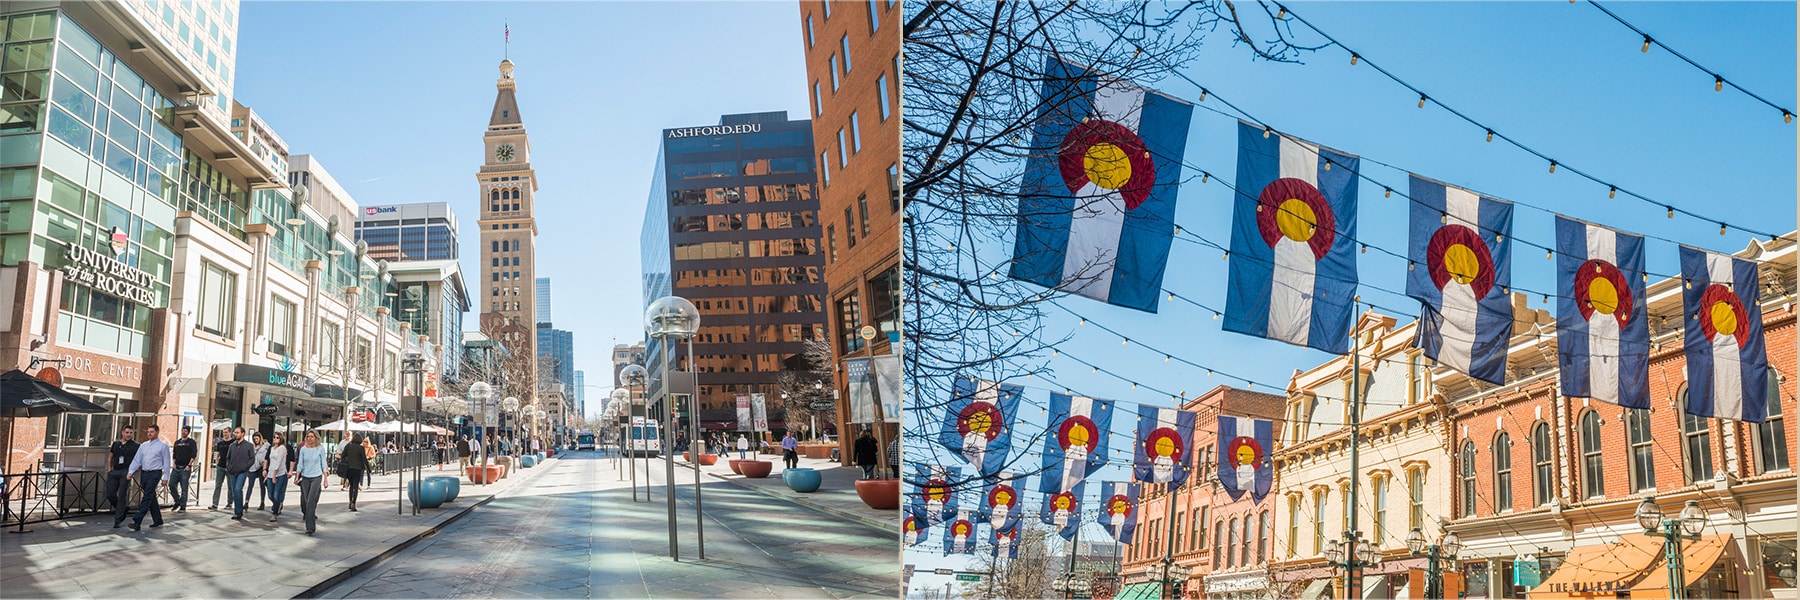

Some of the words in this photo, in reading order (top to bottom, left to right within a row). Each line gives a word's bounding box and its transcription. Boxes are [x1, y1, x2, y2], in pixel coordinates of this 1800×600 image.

[668, 124, 761, 138] ASHFORD.EDU
[70, 242, 156, 289] UNIVERSITY
[68, 265, 81, 281] of
[81, 268, 94, 283] the
[96, 272, 155, 307] ROCKIES
[755, 419, 766, 428] 16
[1549, 583, 1568, 592] THE
[1573, 580, 1630, 592] WALKWAY
